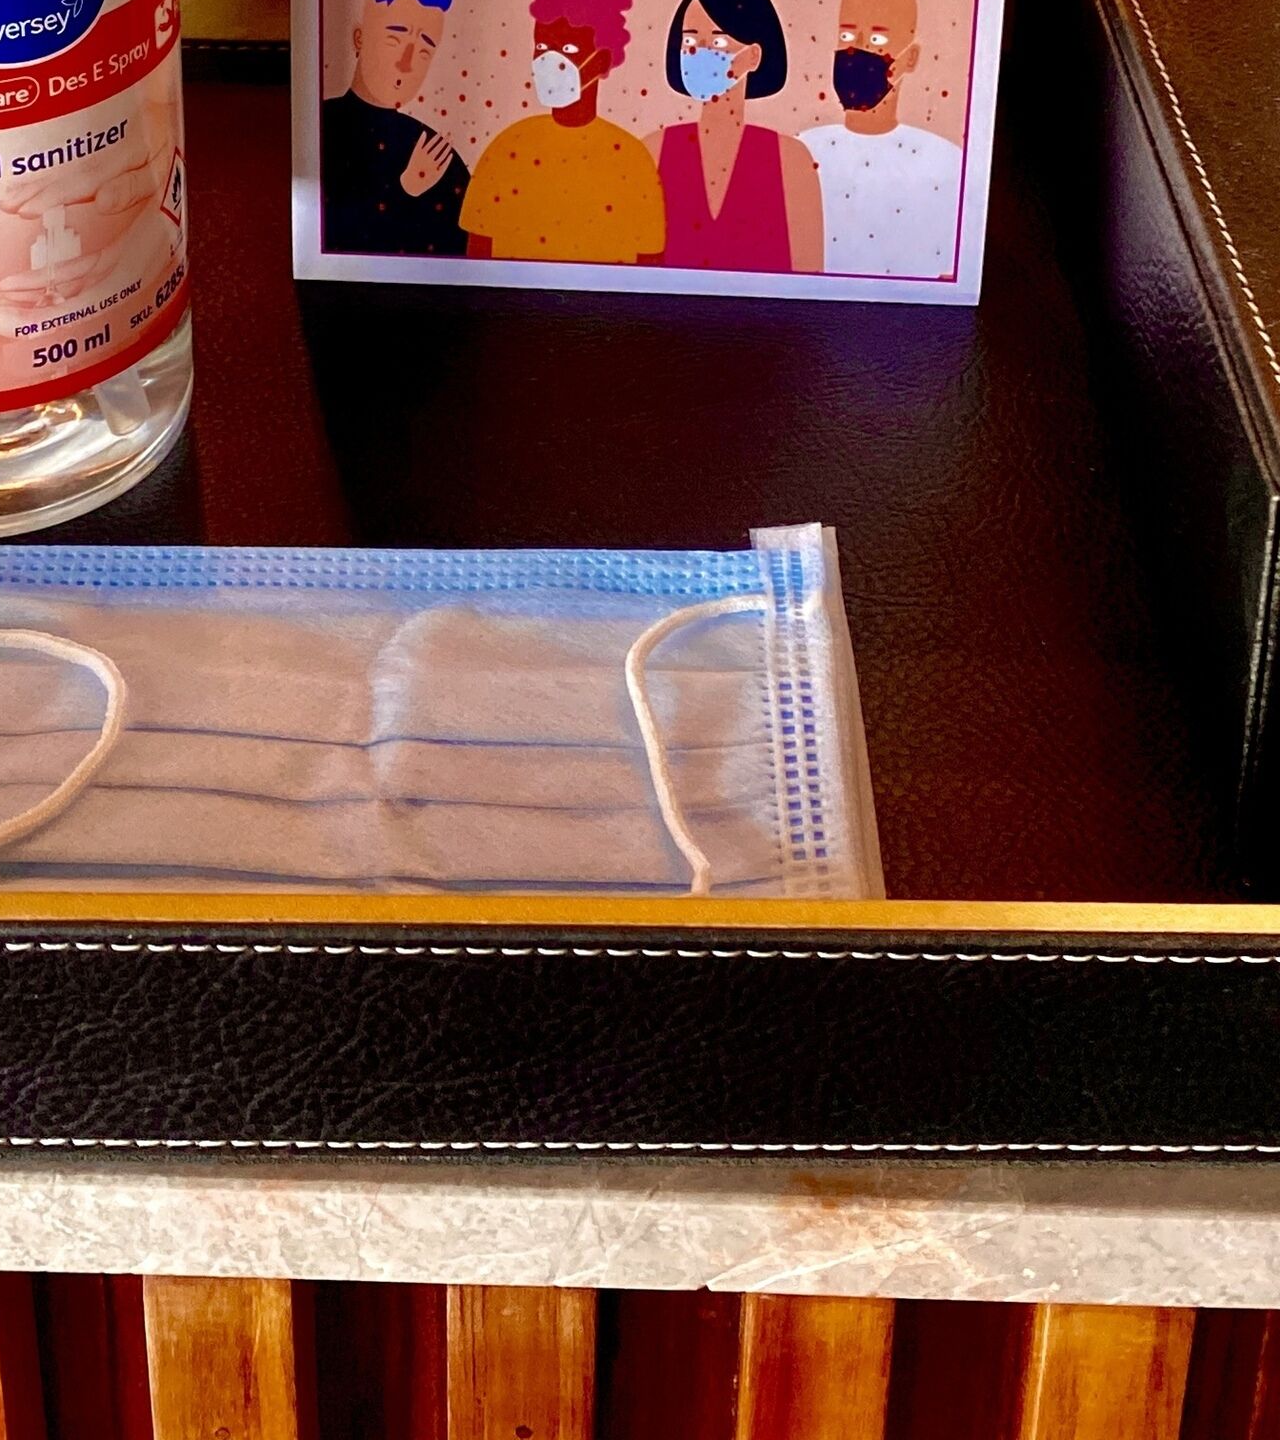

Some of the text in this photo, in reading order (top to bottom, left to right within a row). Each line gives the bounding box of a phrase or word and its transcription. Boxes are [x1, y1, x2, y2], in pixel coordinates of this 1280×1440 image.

[49, 72, 87, 96] Des
[93, 61, 103, 82] E
[109, 39, 150, 74] Spray
[12, 120, 128, 175] sanitizer
[15, 279, 142, 337] FOR EXTERNAL USE ONLY
[130, 306, 152, 329] SKU:
[155, 266, 184, 308] 6285
[33, 324, 110, 367] 500 ml
